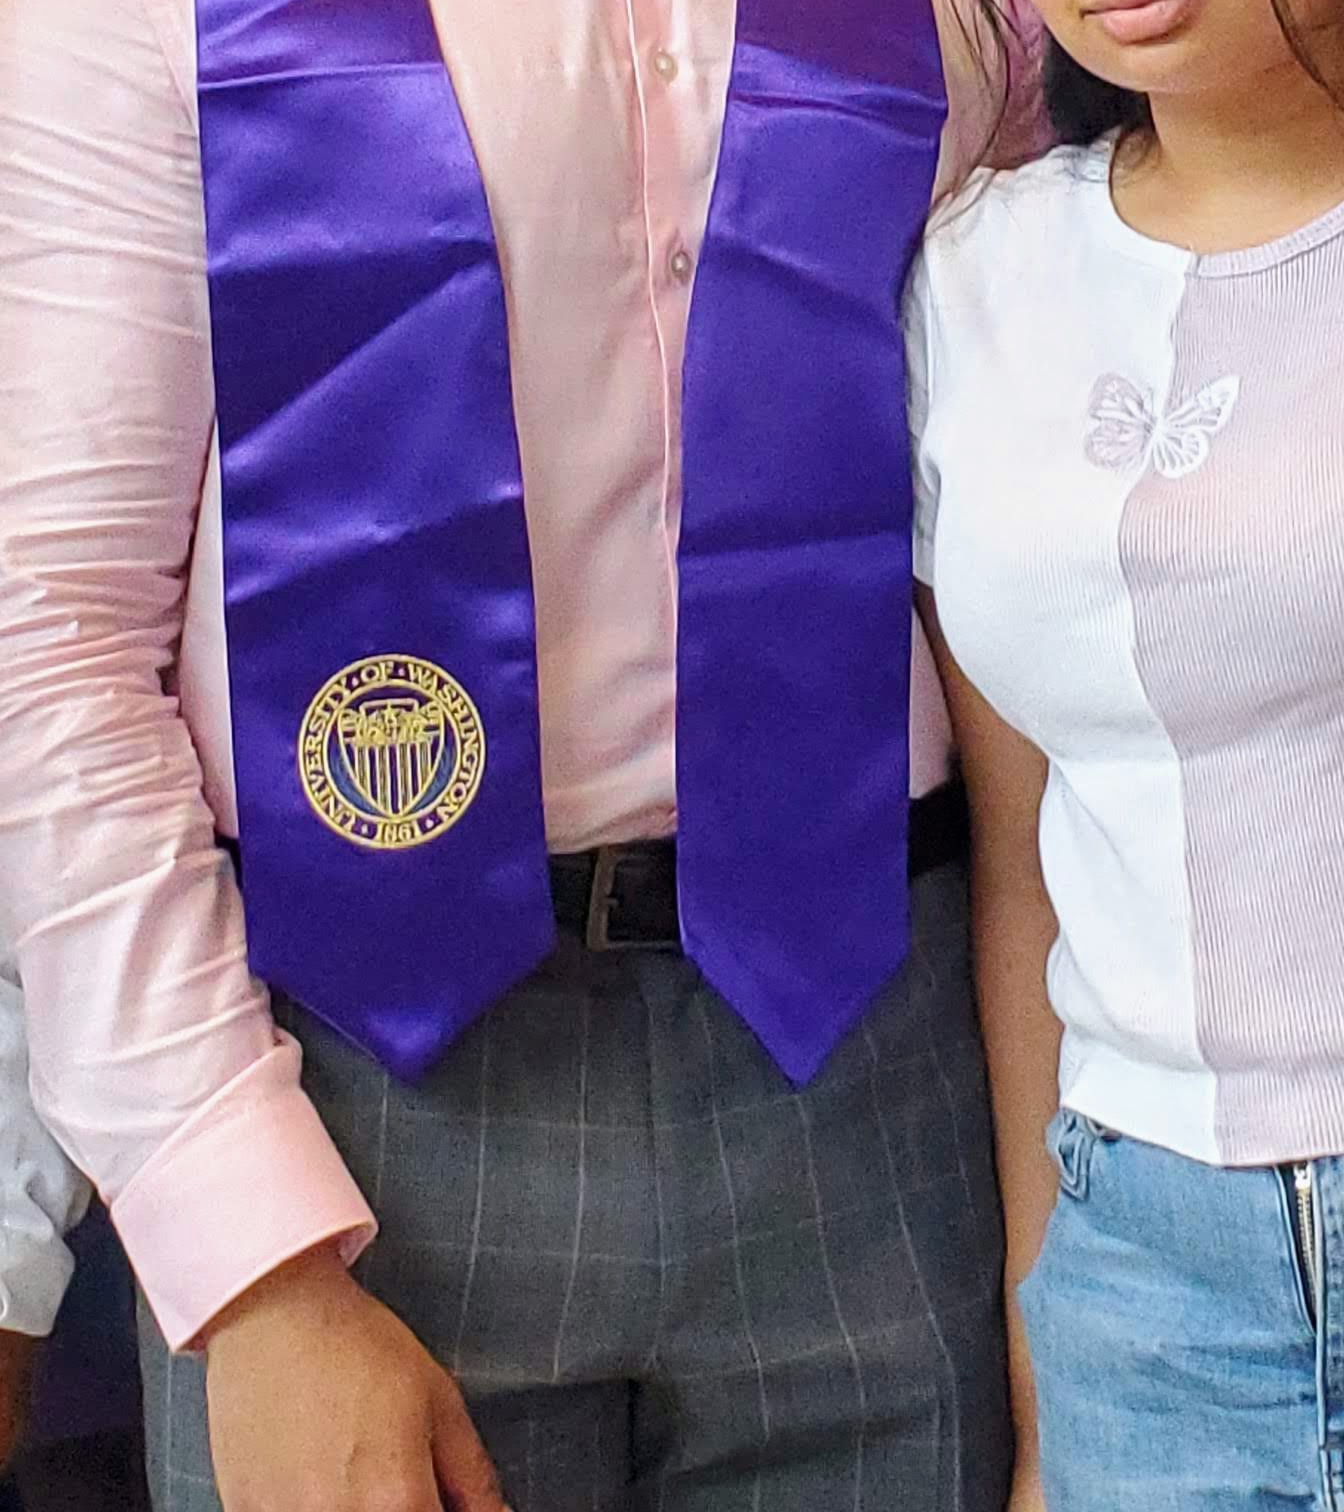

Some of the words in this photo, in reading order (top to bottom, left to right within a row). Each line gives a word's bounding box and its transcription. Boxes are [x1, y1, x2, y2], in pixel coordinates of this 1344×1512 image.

[305, 678, 355, 833] UNIVERSITY
[360, 661, 394, 685] OF
[408, 662, 480, 825] WASHINGTON
[376, 820, 422, 842] 1861
